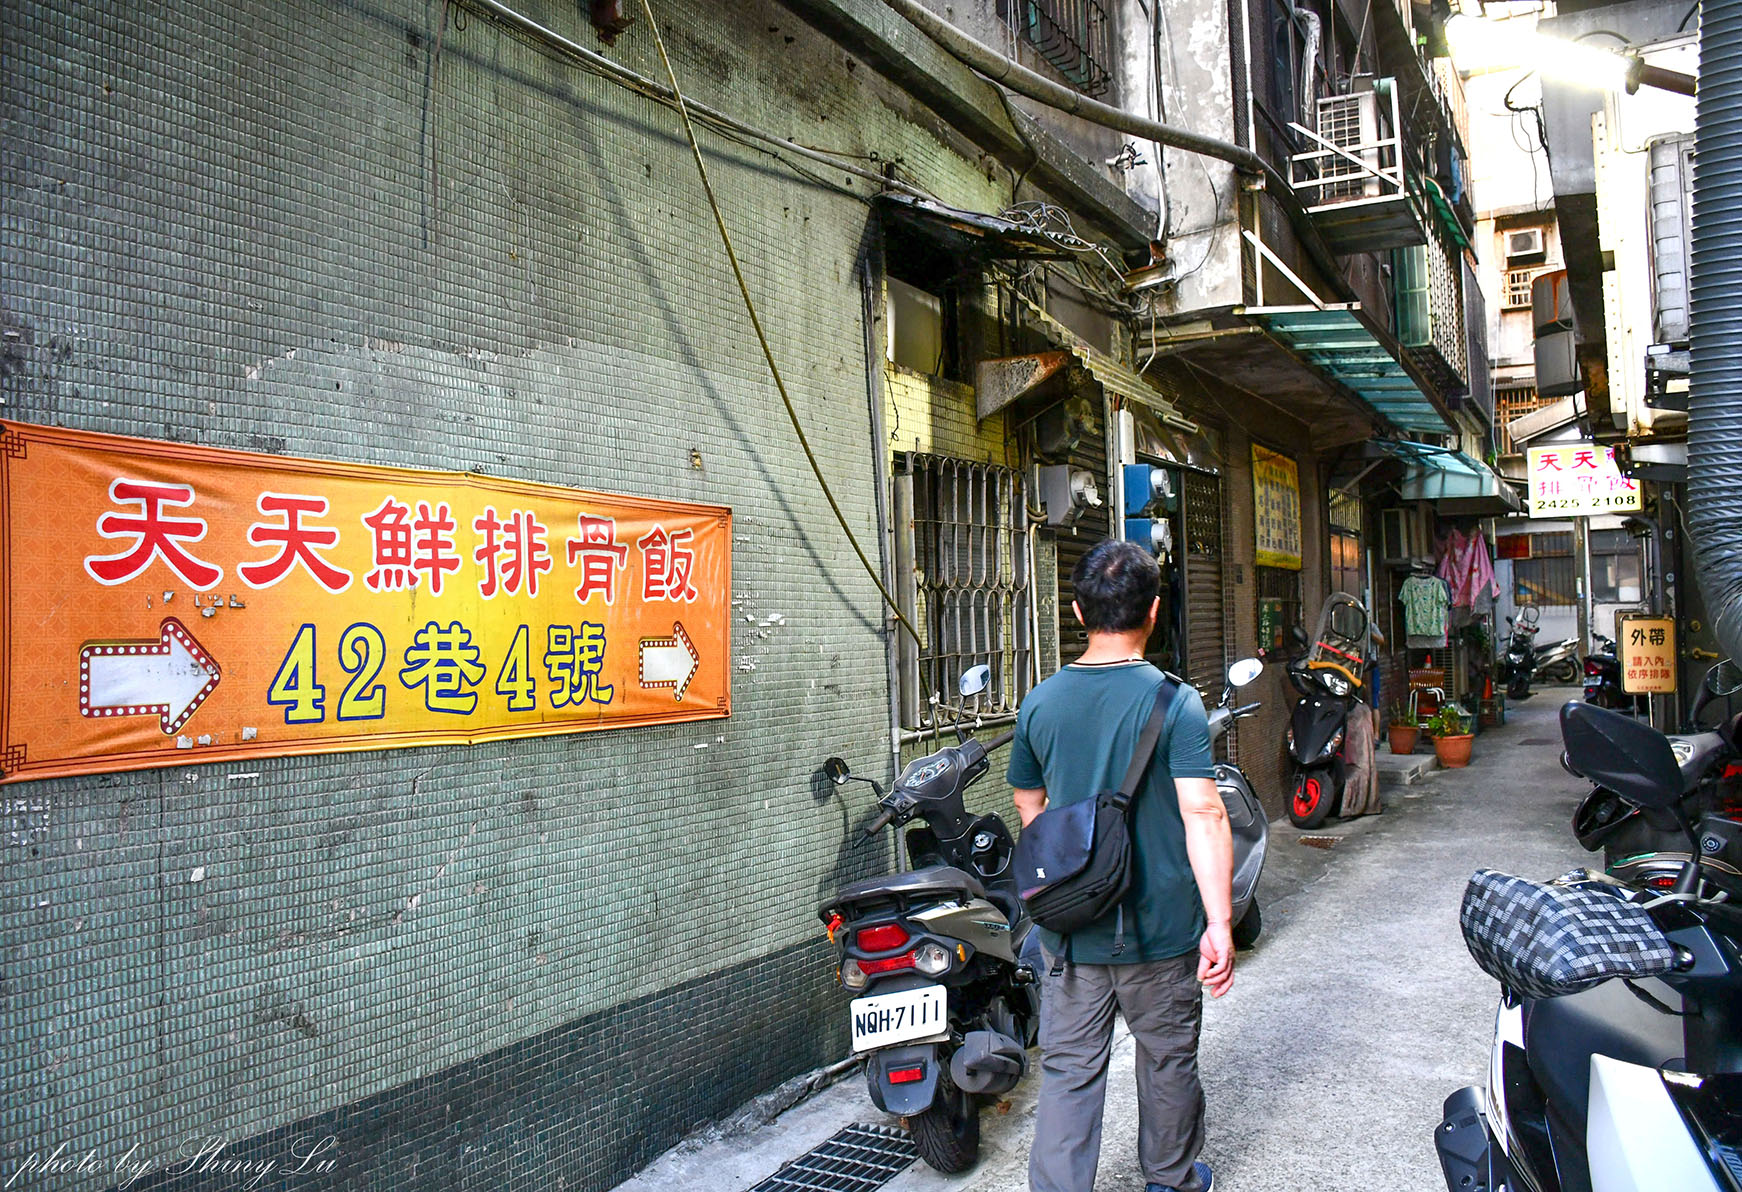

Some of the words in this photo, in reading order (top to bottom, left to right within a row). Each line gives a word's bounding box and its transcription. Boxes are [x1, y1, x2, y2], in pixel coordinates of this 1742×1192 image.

[1537, 499, 1580, 510] 2425
[1592, 495, 1636, 507] 2108
[84, 478, 698, 606] 天天鮮排骨飯
[1631, 627, 1665, 647] 外帶
[1632, 656, 1665, 667] 請入內
[267, 620, 613, 725] 42巷4號
[1627, 668, 1671, 680] 依序排隊
